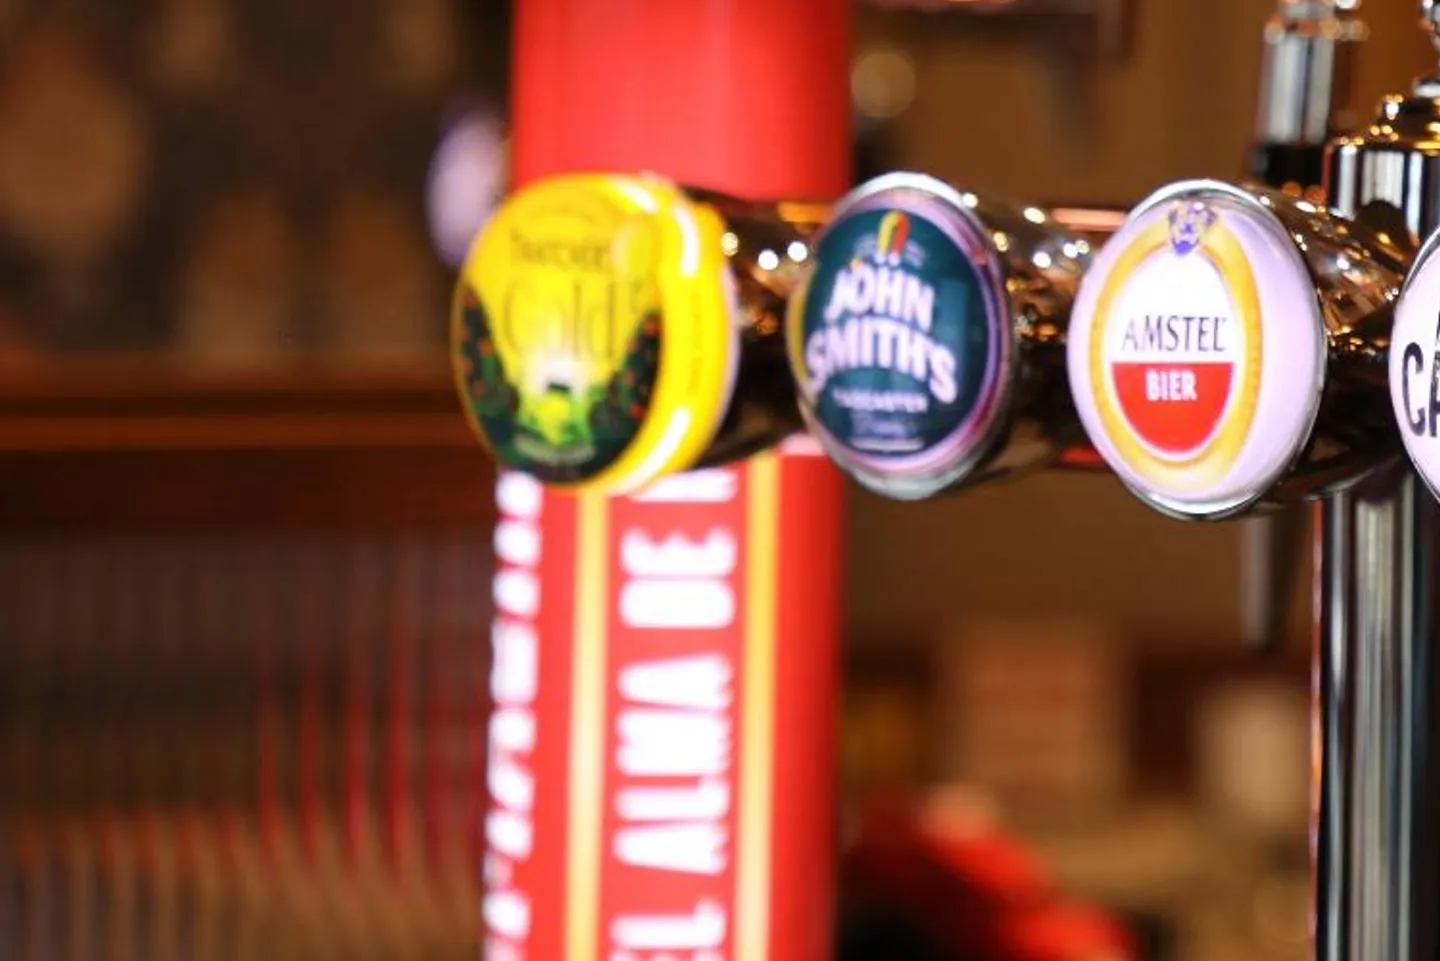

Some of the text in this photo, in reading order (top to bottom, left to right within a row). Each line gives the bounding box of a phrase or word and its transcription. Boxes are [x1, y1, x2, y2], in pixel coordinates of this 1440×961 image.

[824, 258, 935, 334] JOHN
[806, 317, 957, 404] SMITH'S
[1120, 314, 1226, 352] AMSTEL
[1144, 369, 1198, 401] BIER
